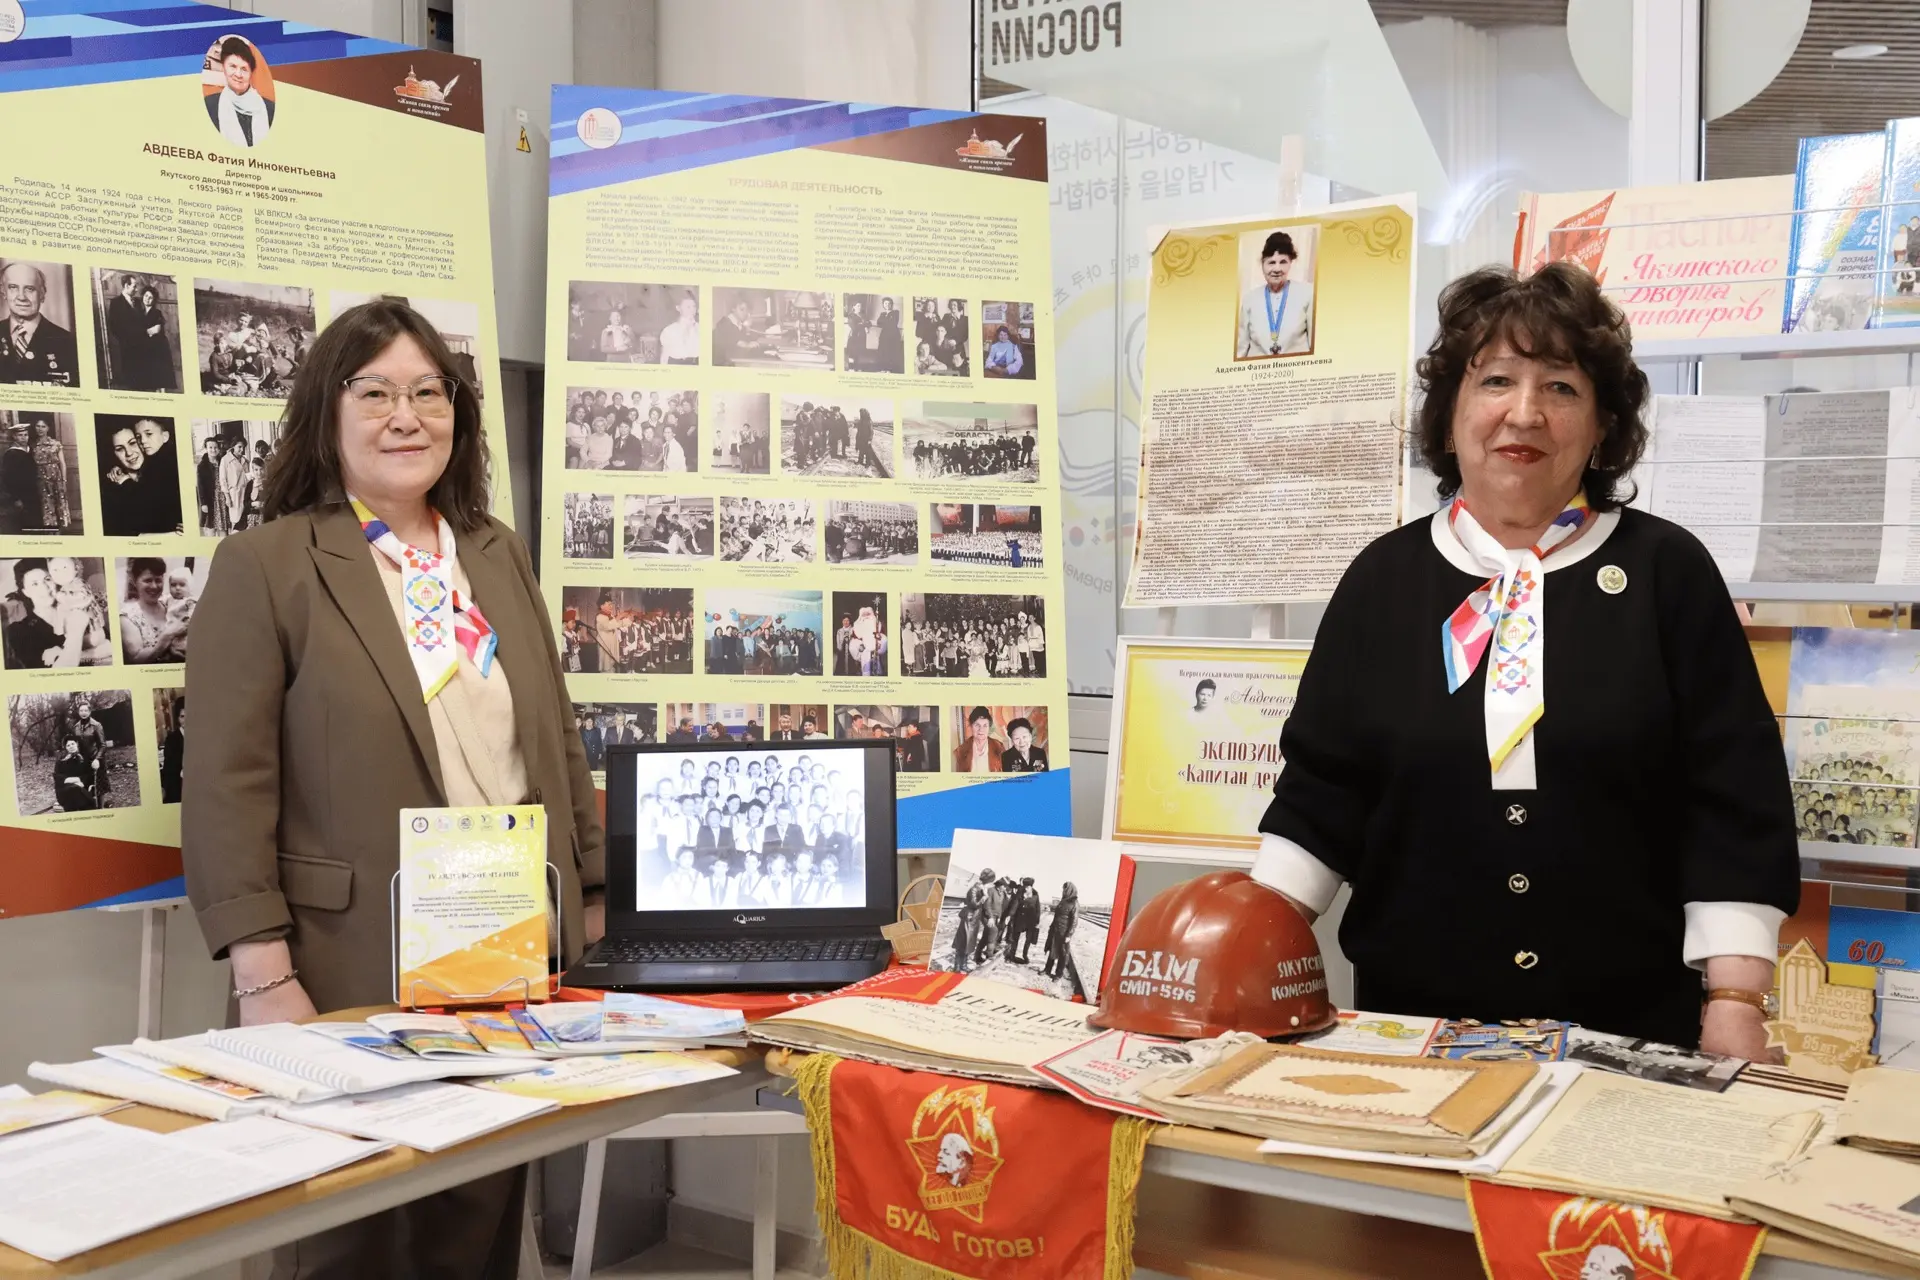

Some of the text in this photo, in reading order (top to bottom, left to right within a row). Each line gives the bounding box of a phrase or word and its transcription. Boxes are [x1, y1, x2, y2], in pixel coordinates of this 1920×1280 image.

[143, 142, 336, 180] АВДЕЕВА Фатия Иннокентьевна
[160, 169, 201, 181] Якутского
[201, 176, 231, 186] дворца
[232, 180, 270, 192] пионеров
[277, 187, 323, 198] школьников
[225, 169, 262, 181] Директор
[14, 177, 56, 189] Родилась
[75, 186, 97, 195] июня
[102, 188, 121, 197] 1924
[125, 192, 143, 201] года
[178, 198, 212, 209] Ленского
[216, 204, 243, 213] района
[196, 184, 234, 195] 1953-1963
[252, 191, 288, 202] 1965-2009
[727, 177, 883, 196] ТРУДОВАЯ ДЕЯТЕЛЬНОСТЬ
[77, 195, 137, 209] Заслуженный
[141, 203, 174, 214] учитель
[178, 208, 215, 219] Якутской
[254, 208, 265, 216] ЦК
[266, 209, 293, 219] ВЛКСМ
[308, 217, 340, 226] активное
[0, 216, 57, 228] просвещения
[86, 224, 126, 237] Почетный
[60, 203, 98, 213] работник
[102, 209, 139, 219] культуры
[213, 222, 244, 232] орденов
[254, 217, 301, 229] Всемирного
[6, 225, 30, 236] Книгу
[31, 228, 61, 239] Почета
[63, 231, 112, 244] Всесоюзной
[211, 231, 245, 241] отличник
[255, 227, 320, 240] подвижничество
[405, 243, 455, 255] Министерства
[255, 236, 303, 247] образования
[1857, 234, 1879, 247] ле
[1, 235, 27, 246] вклад
[42, 240, 82, 251] развитие
[86, 245, 158, 259] дополнительного
[161, 252, 213, 265] образования
[256, 244, 289, 255] Грамота
[292, 248, 337, 260] Президента
[386, 258, 405, 267] Саха
[1840, 255, 1876, 264] СОЗИДА
[1623, 253, 1779, 281] Якутского
[1837, 264, 1875, 273] ТВОРЧЕС
[1618, 282, 1731, 307] Дворца
[1215, 358, 1333, 374] Авдеева Фатия Иннокентьевна
[1251, 369, 1295, 381] (1924-2020)
[1224, 685, 1297, 704] «Авдеевск
[1198, 740, 1283, 765] ЭКСПОЗИЦ
[1178, 763, 1279, 788] «Капитан дет
[732, 913, 766, 925] AQUARIUS
[1848, 939, 1885, 963] 60
[1120, 950, 1202, 986] БАМ
[1277, 955, 1325, 979] ЯКУТСК
[1119, 979, 1197, 1003] СМП-596
[1816, 986, 1869, 1003] ДВОРЕЦ
[1796, 1004, 1869, 1024] ТВОРЧЕСТВА
[1804, 996, 1870, 1012] ДЕТСКОГО
[1802, 1034, 1819, 1051] 85
[886, 1203, 1044, 1259] БУДЬ ГОТОВ!
